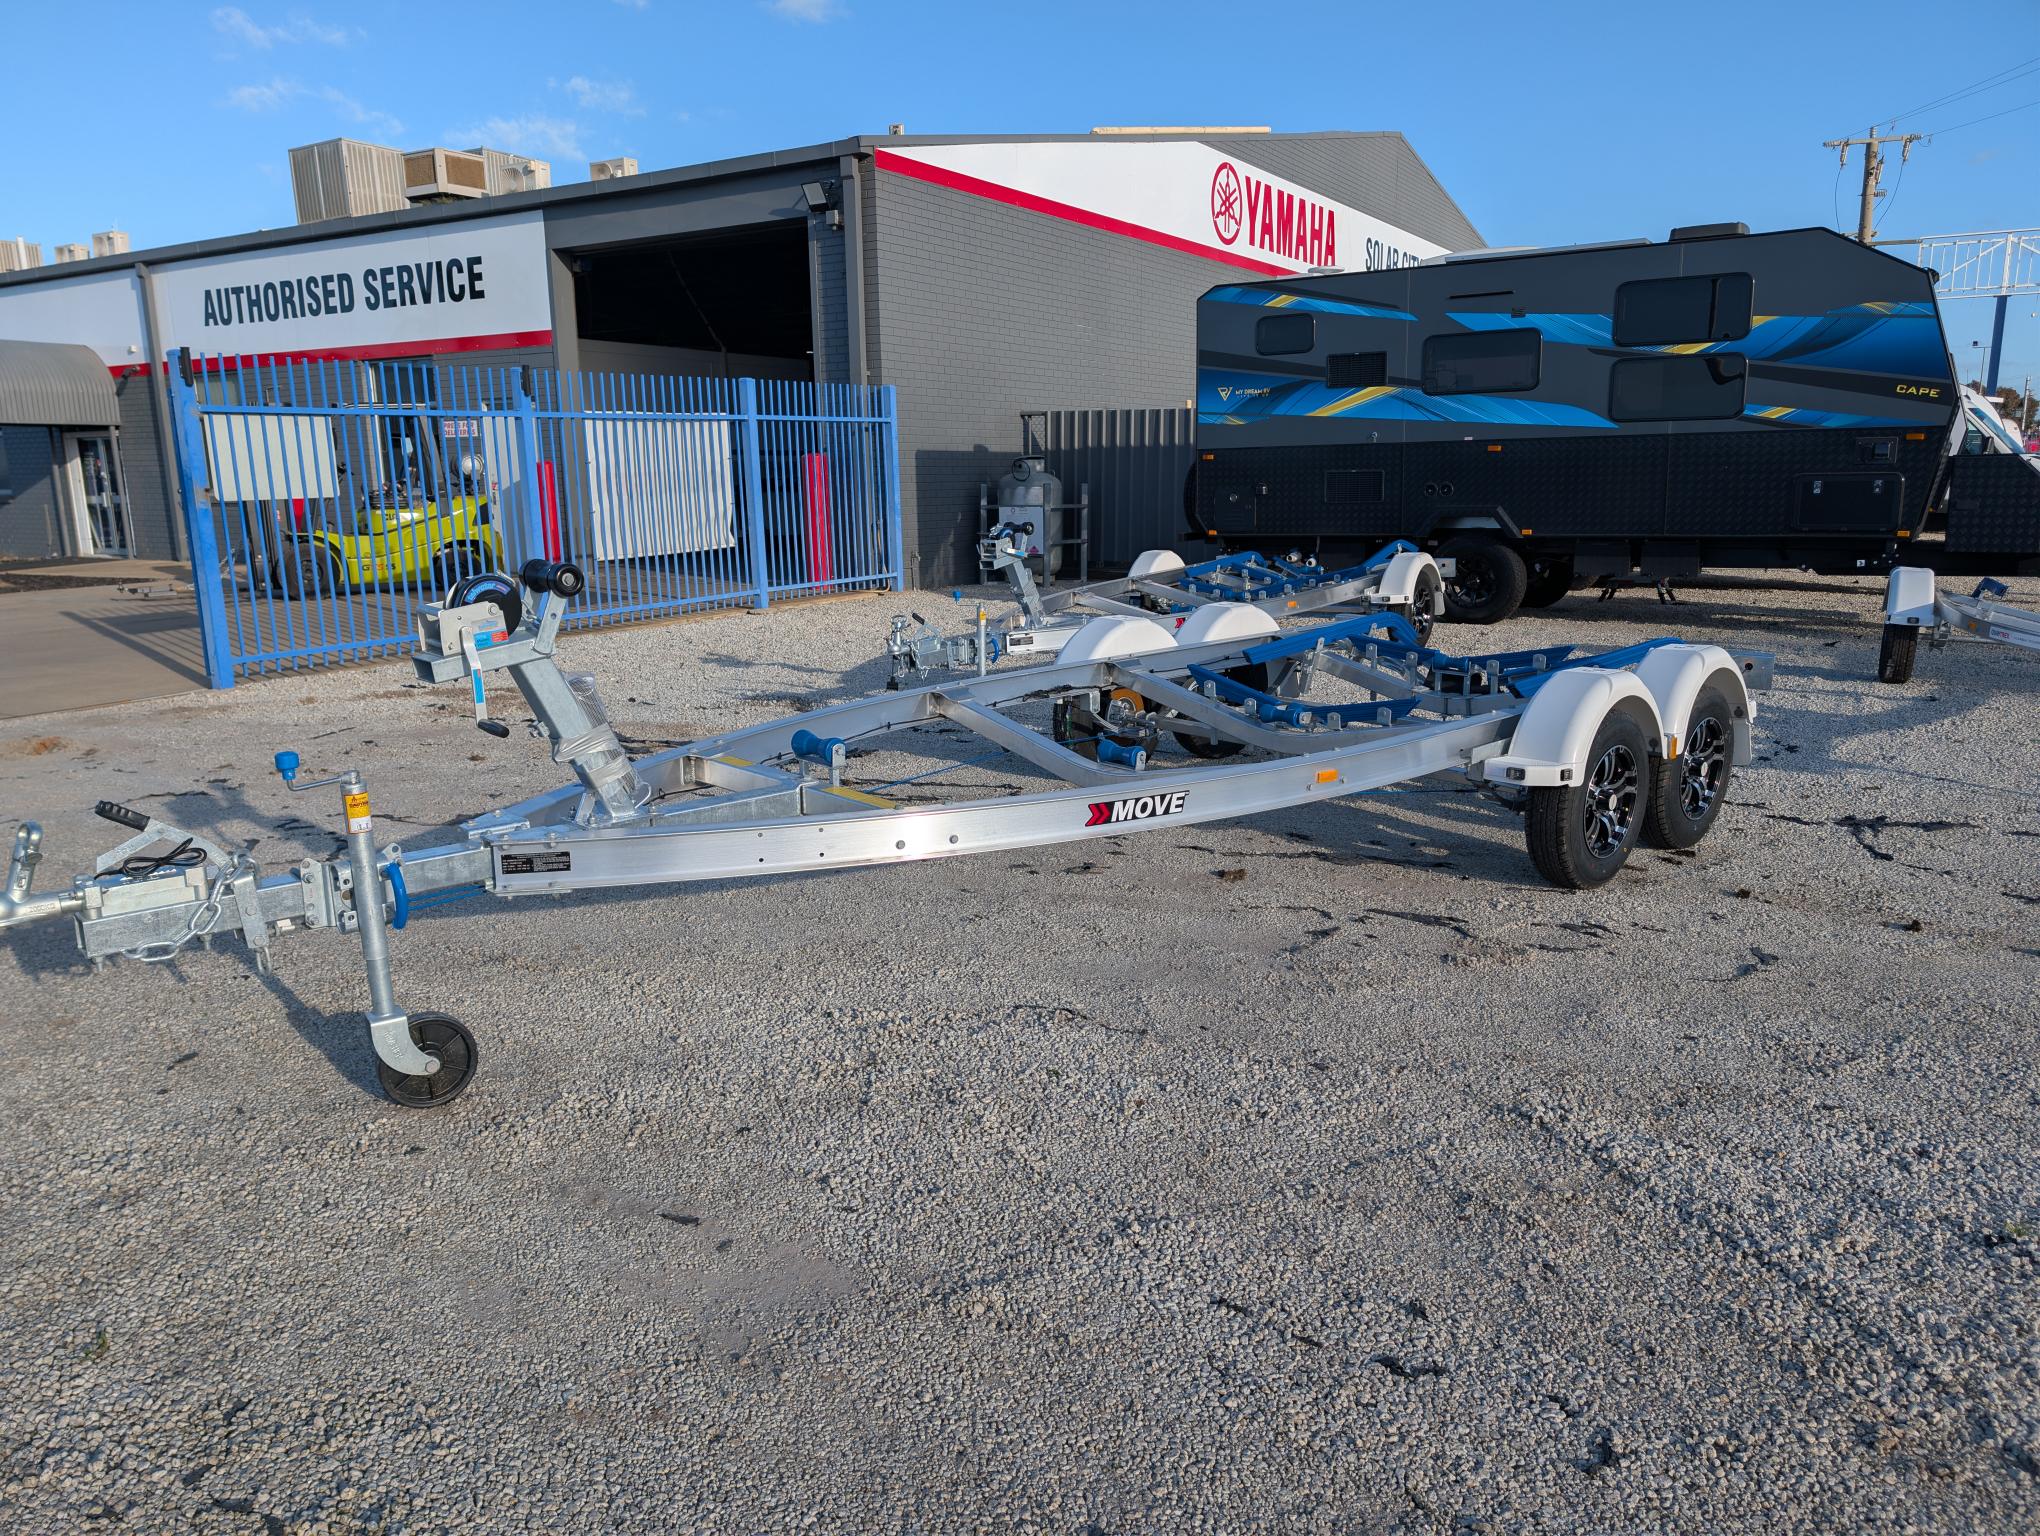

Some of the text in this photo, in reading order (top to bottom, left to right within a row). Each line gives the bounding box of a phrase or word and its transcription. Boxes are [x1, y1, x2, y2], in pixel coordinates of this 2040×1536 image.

[1245, 176, 1335, 267] YAMAHA
[1365, 237, 1399, 271] SOLAR
[204, 256, 485, 327] AUTHORISED SERVICE
[1896, 384, 1941, 398] CAPE
[1111, 791, 1187, 822] MOVE
